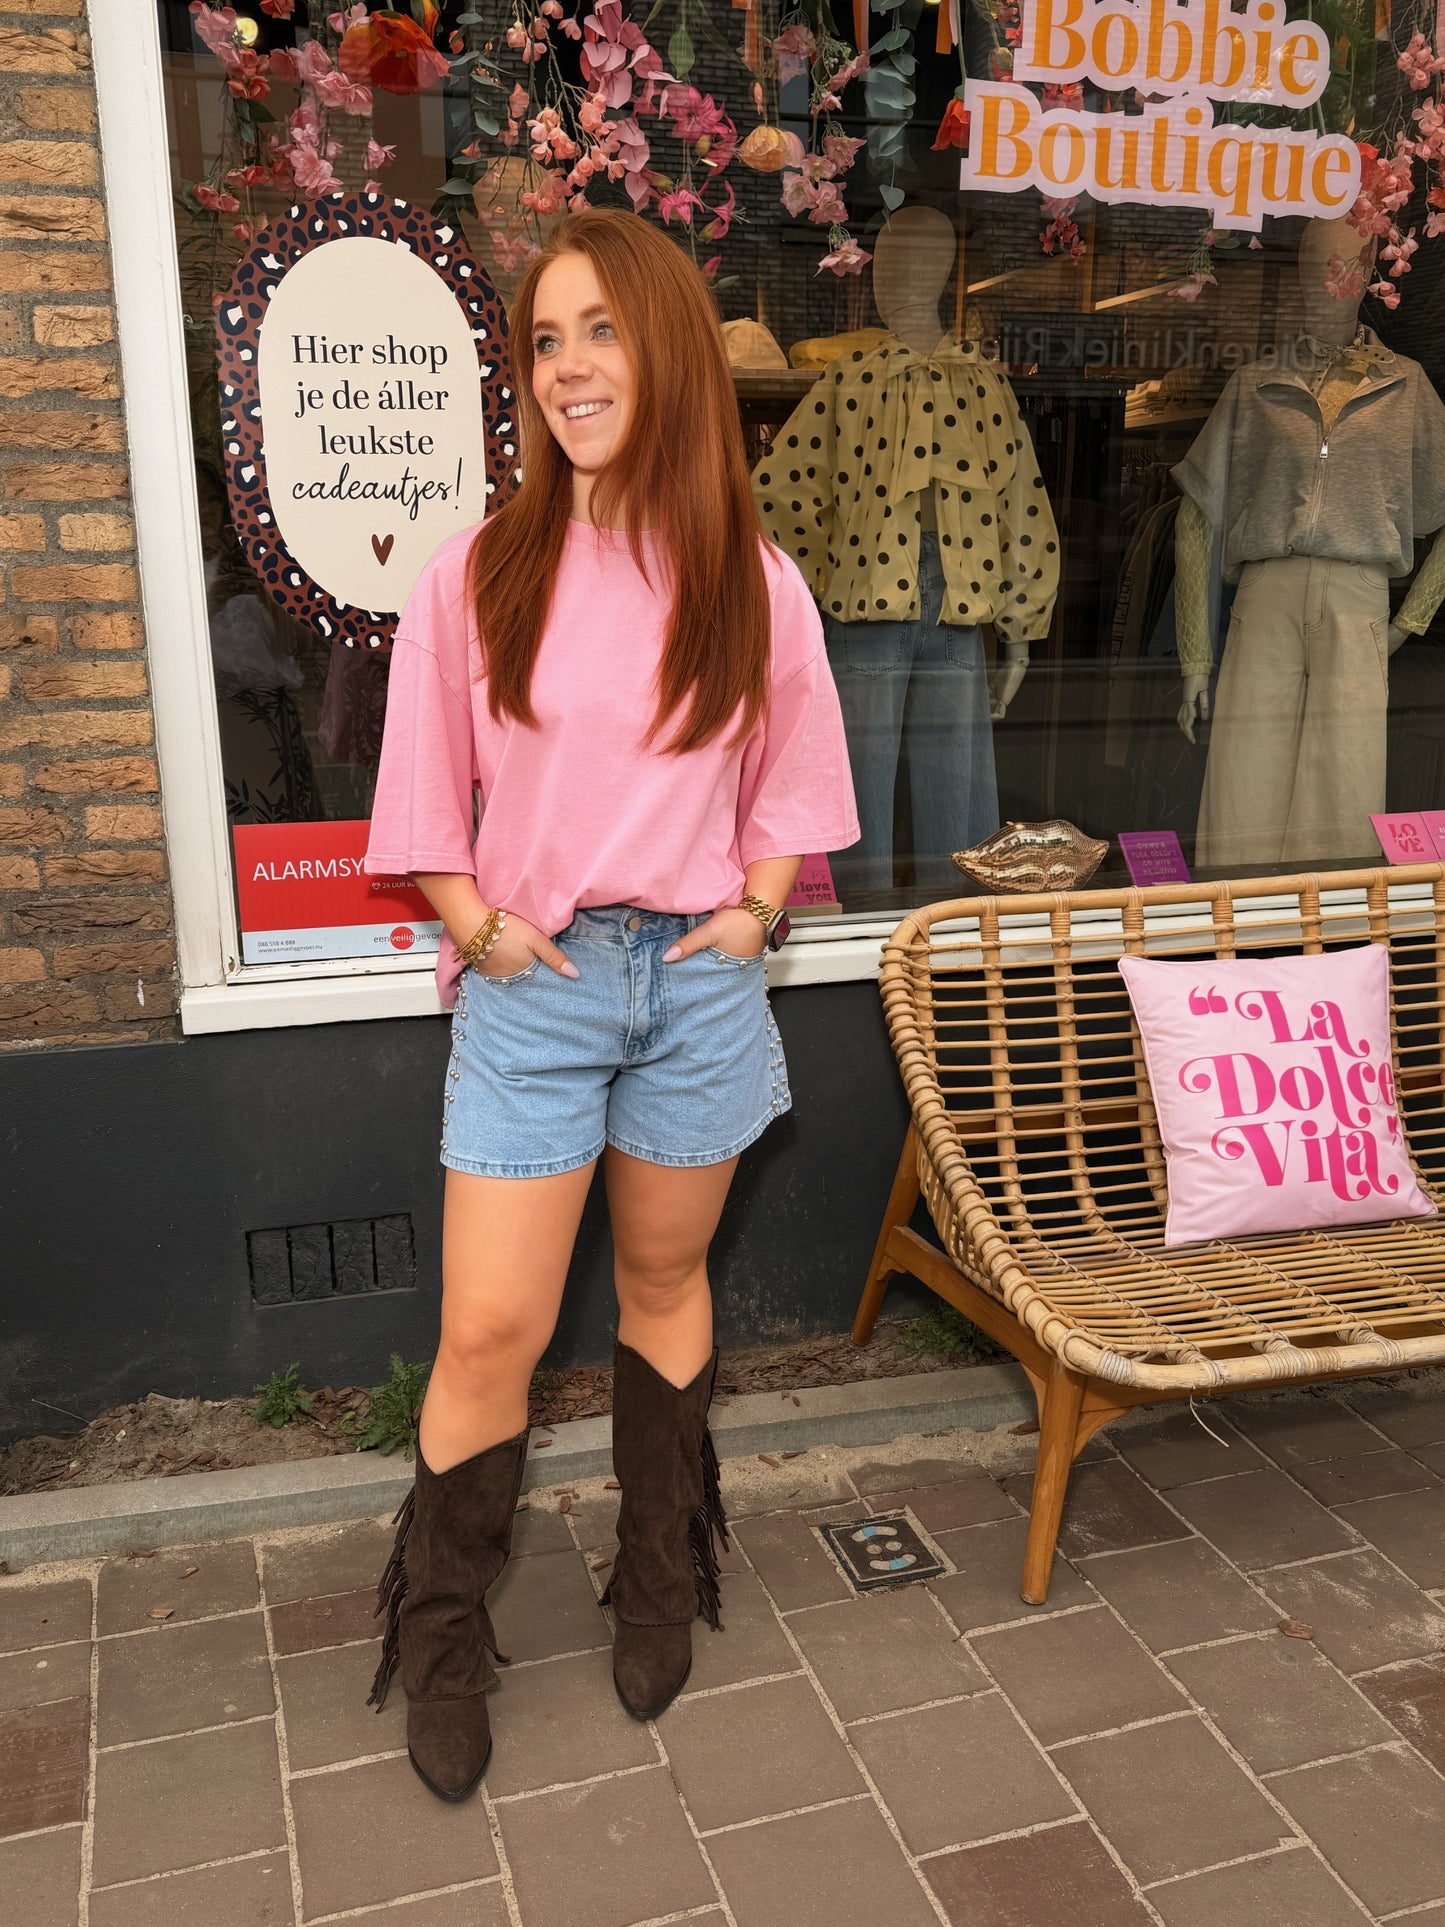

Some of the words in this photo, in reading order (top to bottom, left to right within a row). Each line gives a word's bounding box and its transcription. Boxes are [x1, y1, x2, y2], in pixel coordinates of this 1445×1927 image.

[1026, 0, 1319, 95] Bobbie
[973, 94, 1351, 217] Boutique
[291, 334, 364, 364] Hier
[372, 334, 448, 374] shop
[294, 381, 324, 418] je
[333, 380, 370, 410] de
[378, 379, 449, 411] áller
[318, 425, 434, 456] leukste
[292, 457, 463, 521] cadeautjes!
[252, 858, 364, 881] ALARMSY
[800, 881, 830, 892] love
[806, 893, 832, 905] you
[416, 932, 441, 942] gevoe
[1178, 1046, 1395, 1129] Dolce
